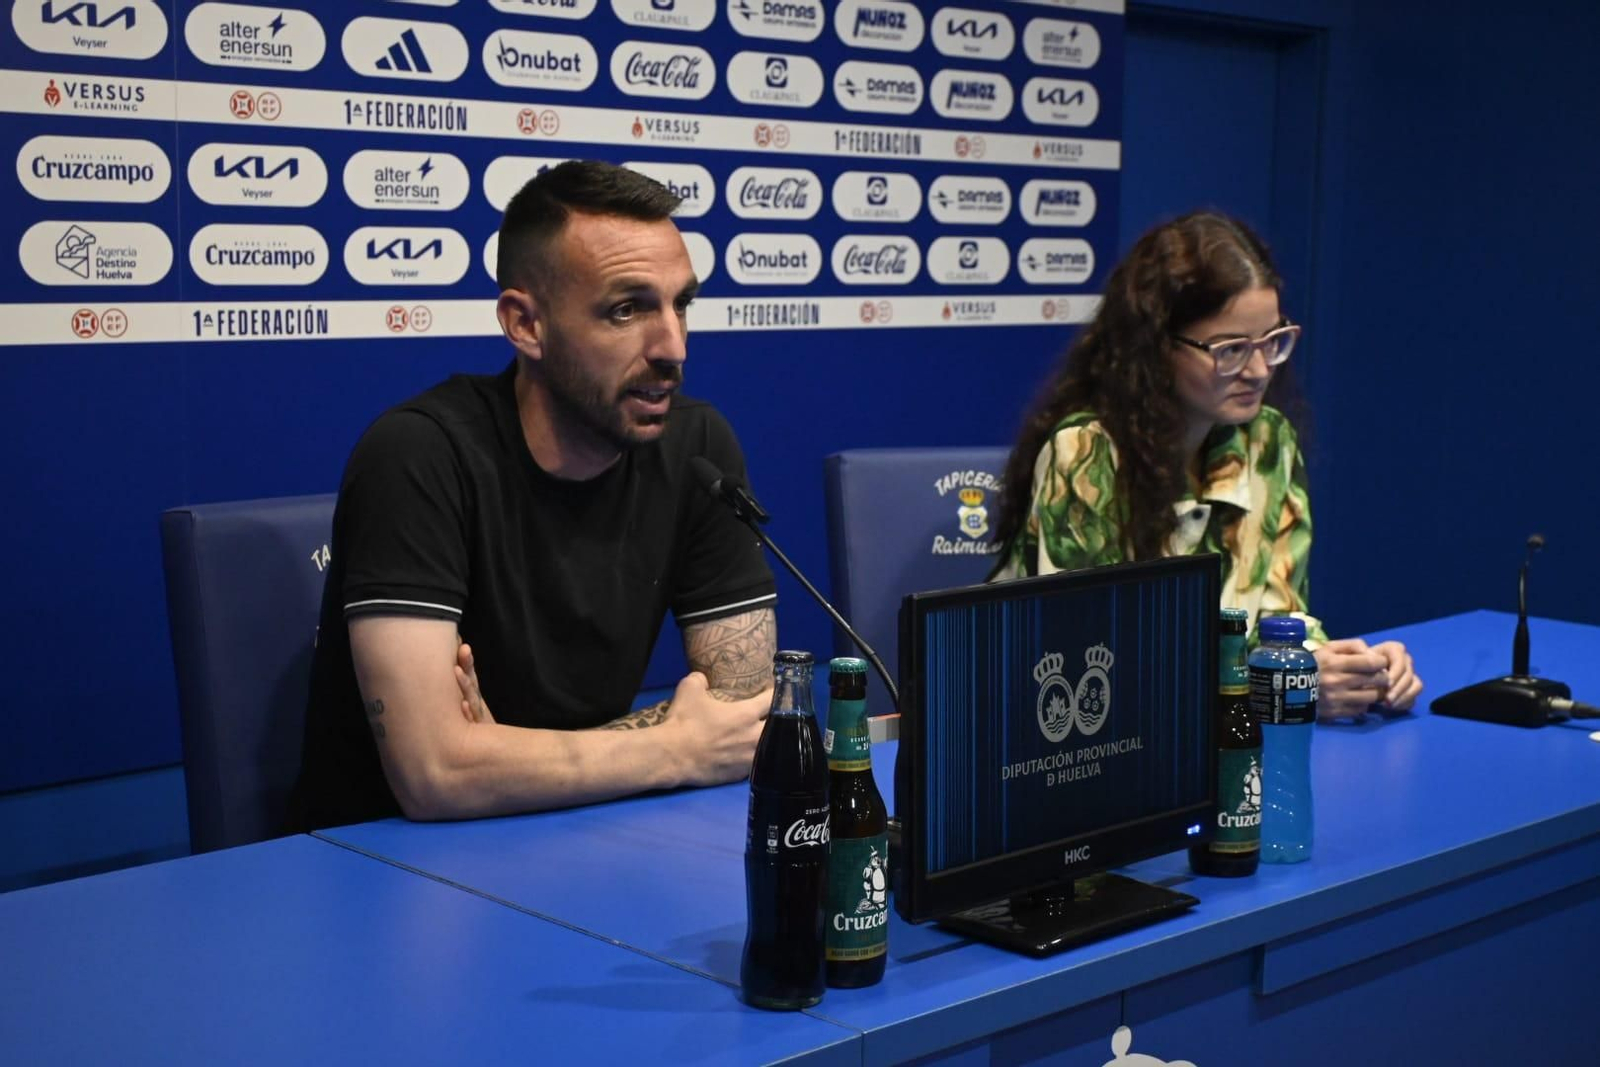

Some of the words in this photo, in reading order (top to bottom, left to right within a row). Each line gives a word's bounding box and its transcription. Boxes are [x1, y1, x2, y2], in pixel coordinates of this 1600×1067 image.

[41, 2, 136, 30] KIA
[763, 2, 816, 19] DAMAS
[220, 21, 260, 39] alter
[73, 36, 107, 49] Veyser
[220, 39, 292, 57] enersun
[502, 46, 581, 73] Onubat
[625, 52, 701, 88] Coca-Cola
[64, 82, 145, 103] VERSUS
[867, 79, 916, 94] DAMAS
[74, 102, 138, 112] E-LEARNING
[366, 100, 467, 131] FEDERACIÓN
[645, 118, 700, 135] VERSUS
[850, 130, 921, 155] FEDERACIÓN
[32, 154, 154, 185] Cruzcampo
[214, 155, 299, 180] KIA
[375, 167, 411, 183] alter
[242, 188, 273, 200] Veyser
[375, 183, 439, 198] enersun
[739, 177, 809, 209] Coca-Cola
[96, 246, 137, 258] Agencia
[205, 243, 315, 269] Cruzcampo
[367, 239, 442, 259] KIA
[96, 257, 136, 268] Destino
[741, 250, 808, 269] Onubat
[843, 245, 909, 275] Coca-Cola
[96, 268, 132, 279] Huelva
[743, 300, 819, 326] FEDERACIÓN
[953, 301, 996, 314] VERSUS
[217, 304, 328, 336] FEDERACIÓN
[934, 469, 1001, 496] TAPICER
[932, 535, 1001, 554] Raimu
[1002, 751, 1074, 780] DIPUTACIÓN
[1076, 736, 1143, 763] PROVINCIAL
[1058, 762, 1101, 785] HUELVA
[1064, 845, 1091, 865] HKC
